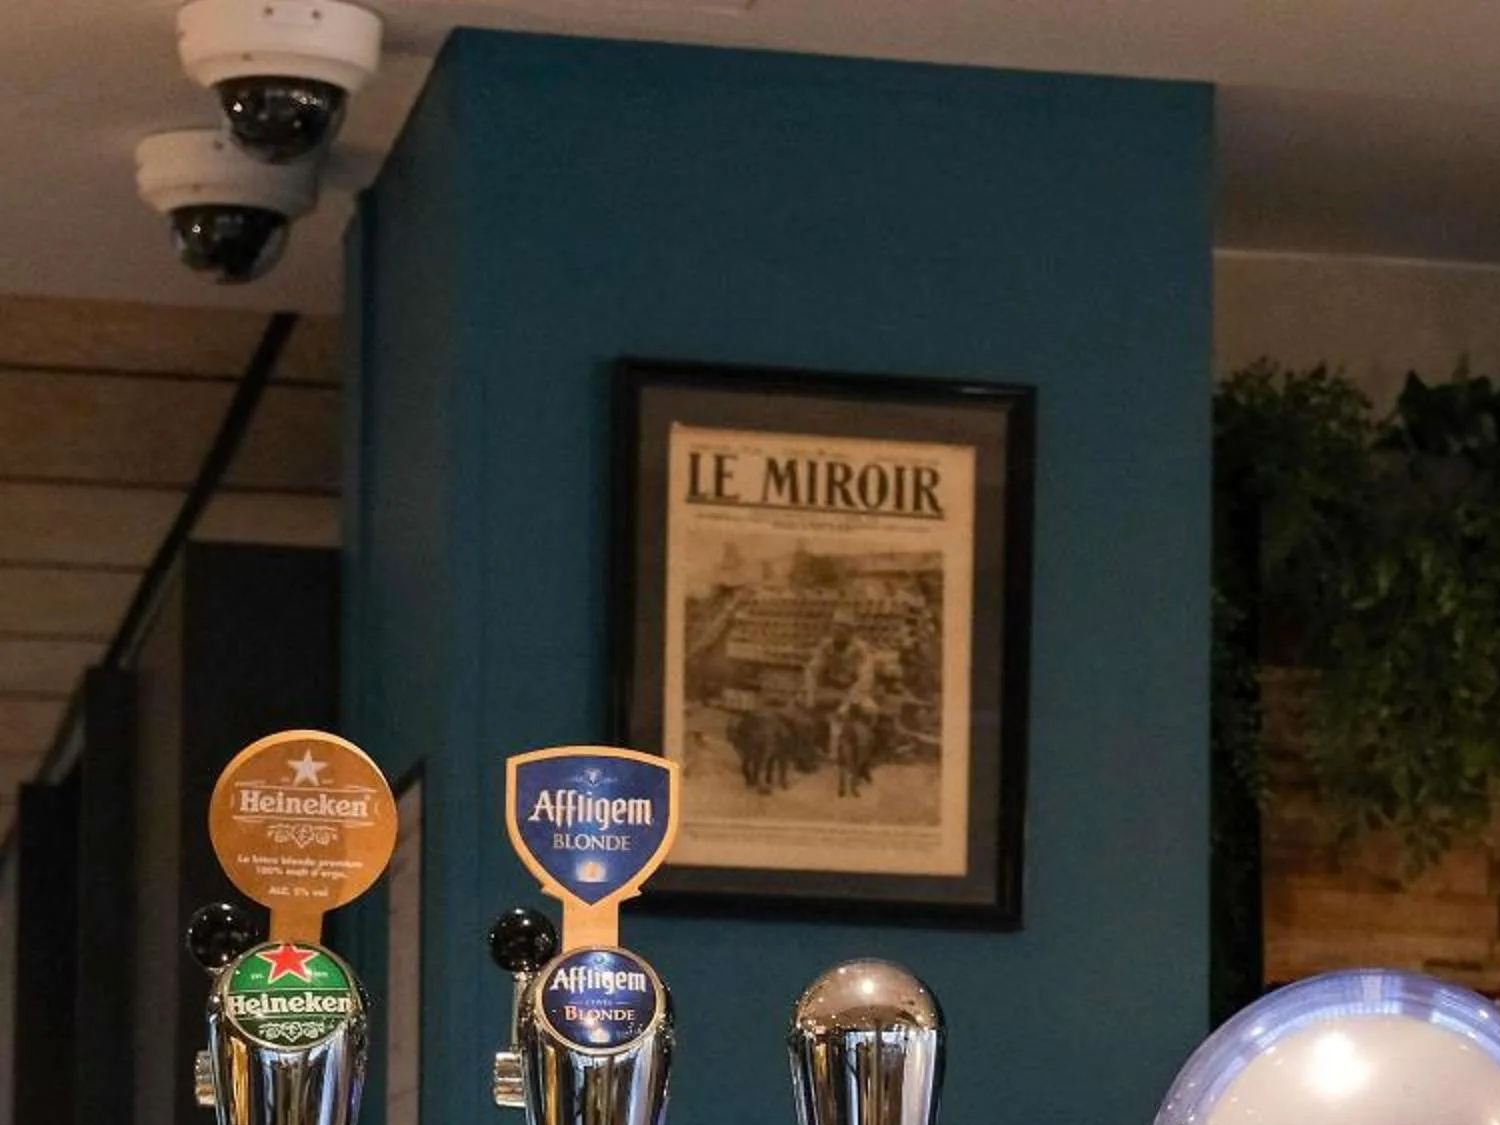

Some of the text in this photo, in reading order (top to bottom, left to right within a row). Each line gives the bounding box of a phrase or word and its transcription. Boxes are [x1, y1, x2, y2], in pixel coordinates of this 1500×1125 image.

[687, 452, 944, 515] LE MIROIR
[240, 789, 368, 817] Heineken
[528, 789, 652, 831] Affligem
[553, 833, 632, 851] BLONDE
[549, 965, 647, 995] Affligem
[228, 991, 351, 1016] Heineken
